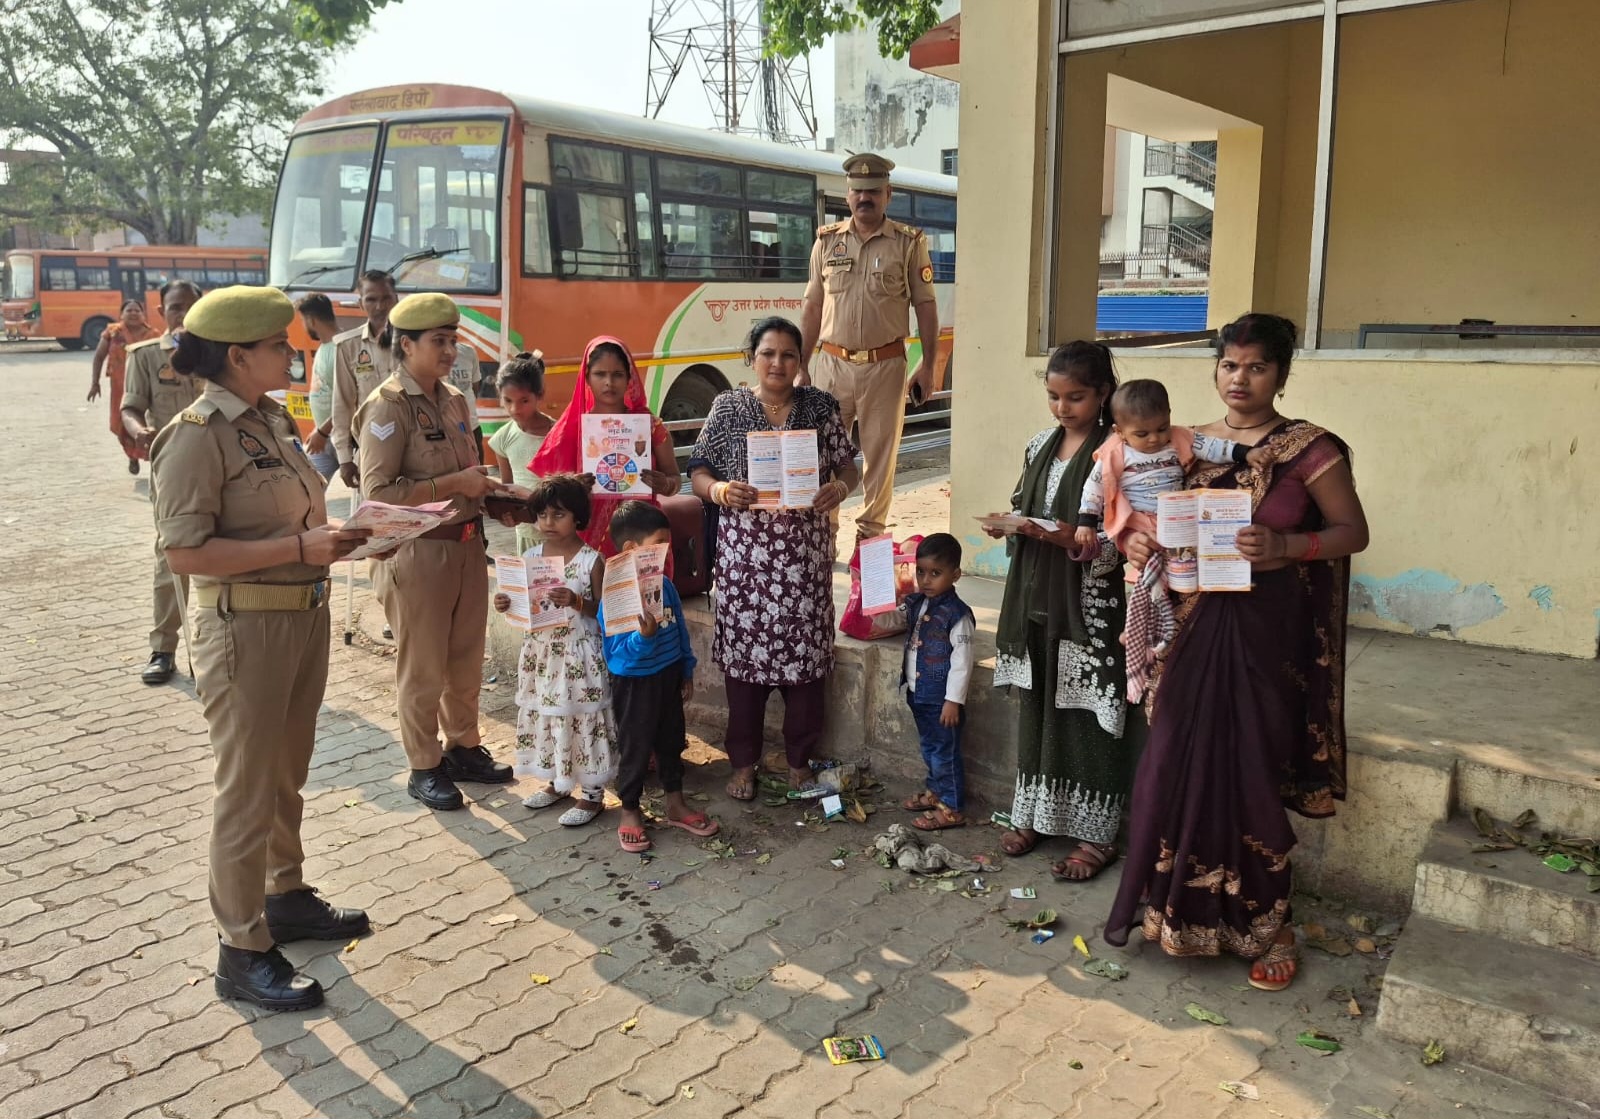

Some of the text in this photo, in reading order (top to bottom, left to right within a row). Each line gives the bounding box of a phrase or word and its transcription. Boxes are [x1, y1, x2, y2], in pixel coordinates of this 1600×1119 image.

[732, 295, 802, 311] उत्तर प्रदेश परिवहन
